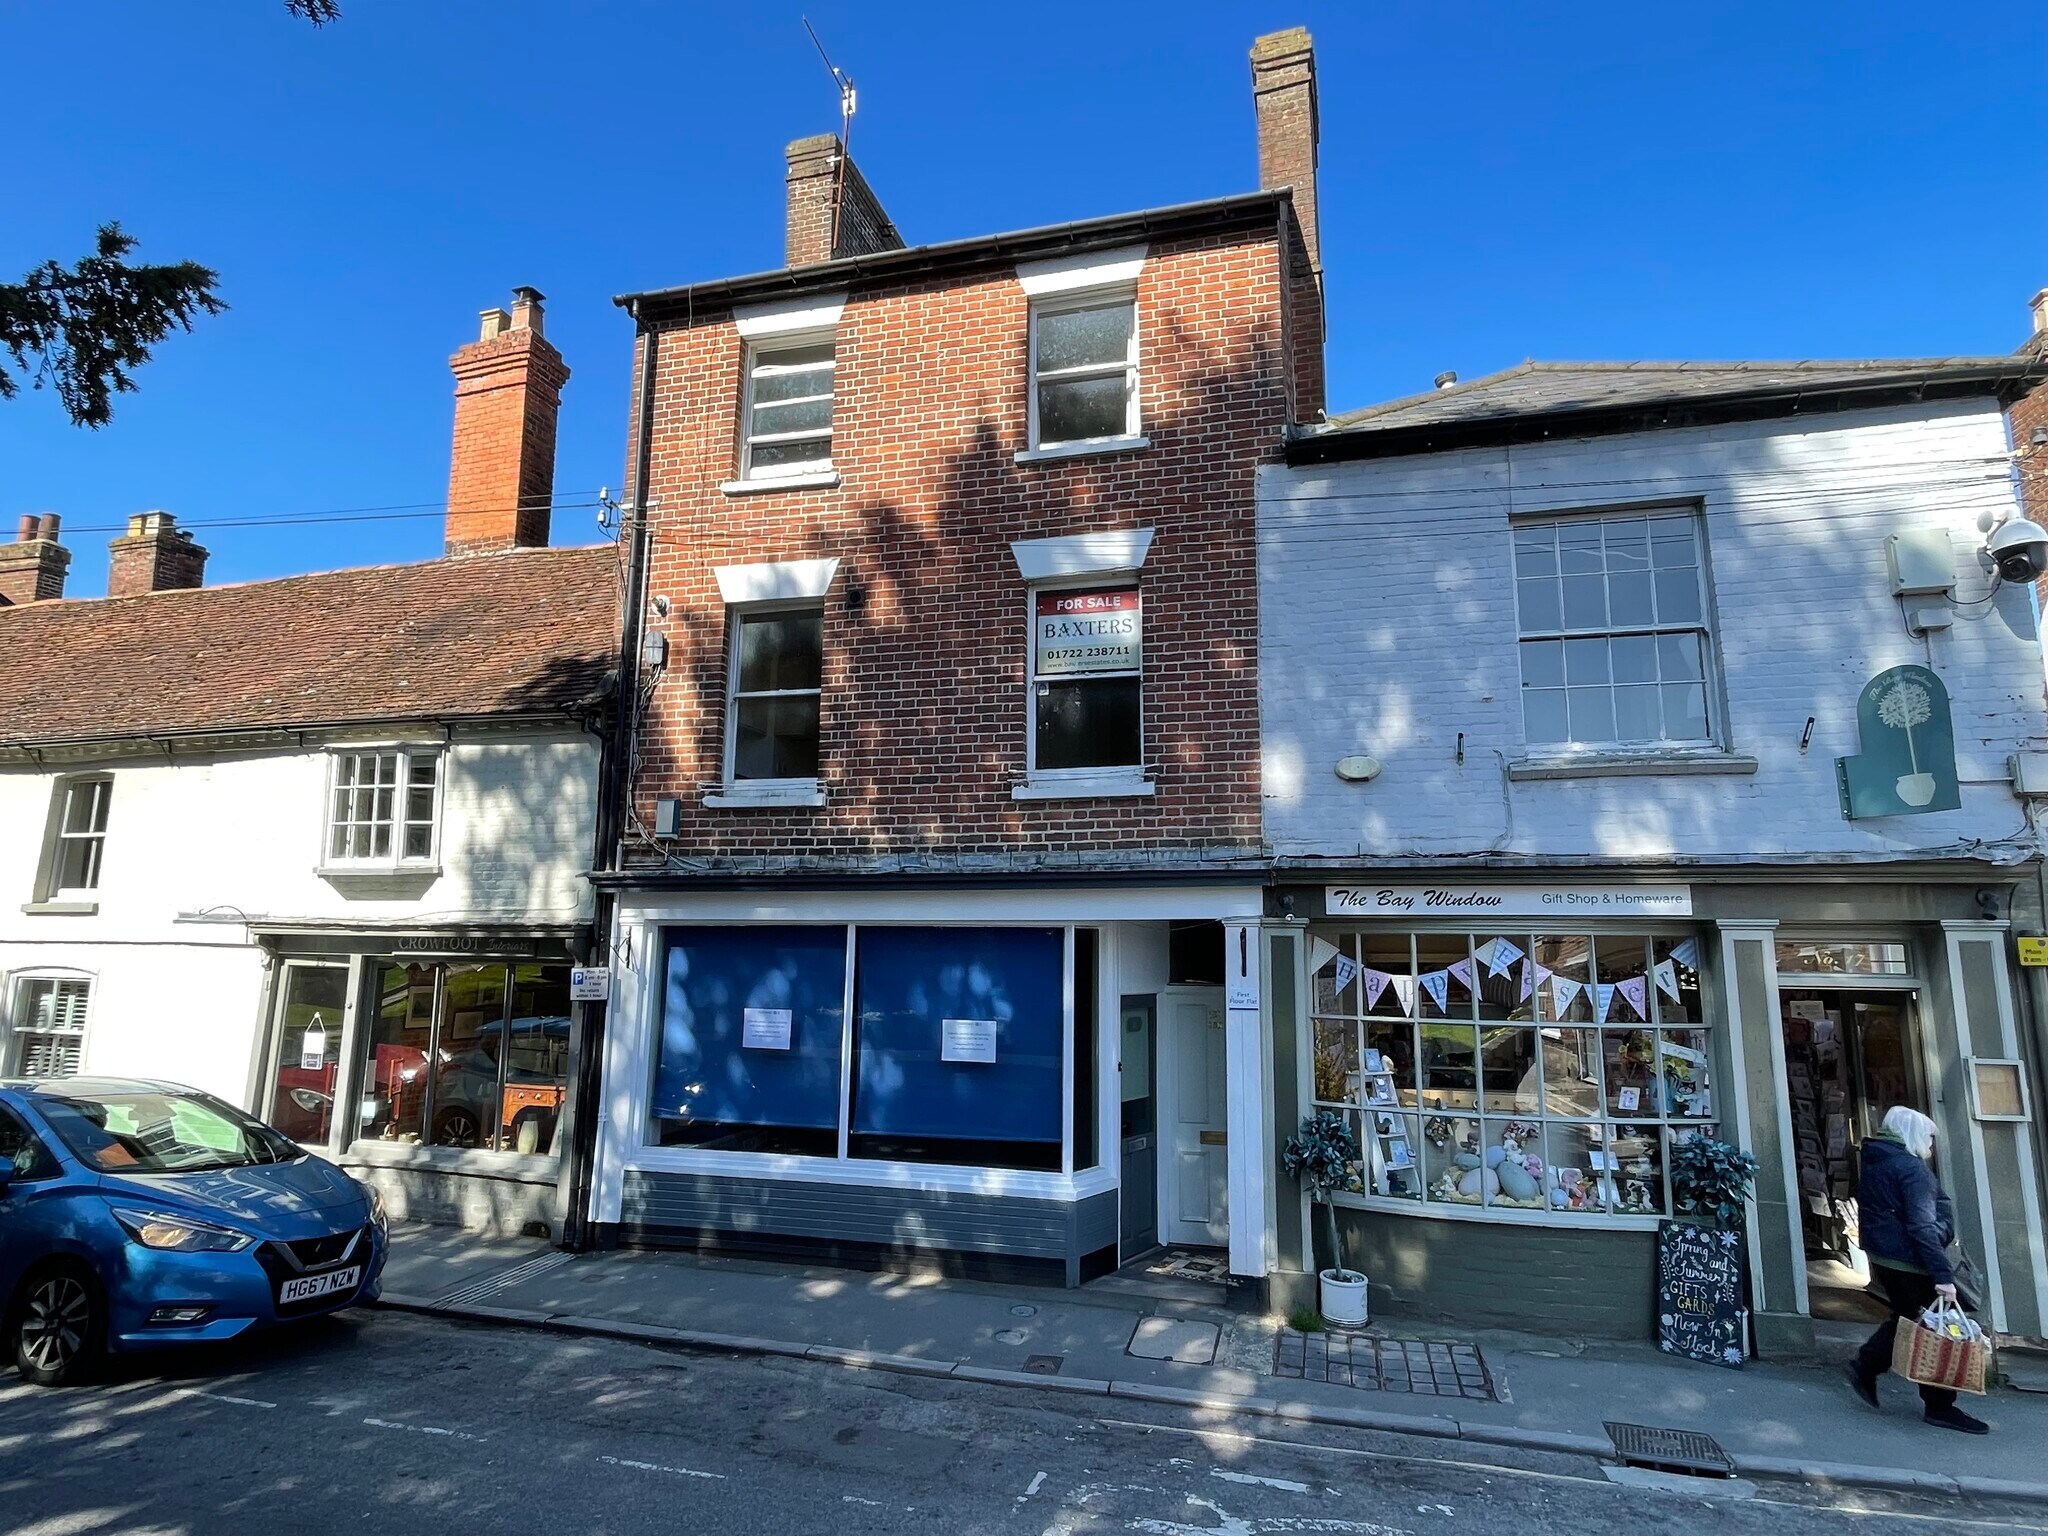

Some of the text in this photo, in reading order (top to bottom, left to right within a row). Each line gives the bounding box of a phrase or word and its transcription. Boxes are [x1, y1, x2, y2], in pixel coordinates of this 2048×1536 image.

[1056, 596, 1121, 611] FOR SALE
[1045, 618, 1133, 639] BAXTERS
[1047, 646, 1130, 660] 01722 238711
[1047, 658, 1130, 668] www.baxersestates.co.uk
[1333, 889, 1503, 911] The Bay Window
[1541, 893, 1683, 906] Gift Shop & Homeware
[398, 936, 530, 951] CROWFOOT Interiors
[1669, 1235, 1710, 1263] Spring
[1674, 1259, 1721, 1283] Summer
[1709, 1256, 1729, 1272] and
[286, 1268, 355, 1299] HG67 NZW
[1669, 1280, 1708, 1300] GIFTS
[1677, 1296, 1715, 1316] CARDS
[1673, 1312, 1723, 1340] Now In
[1680, 1333, 1722, 1358] Stock
